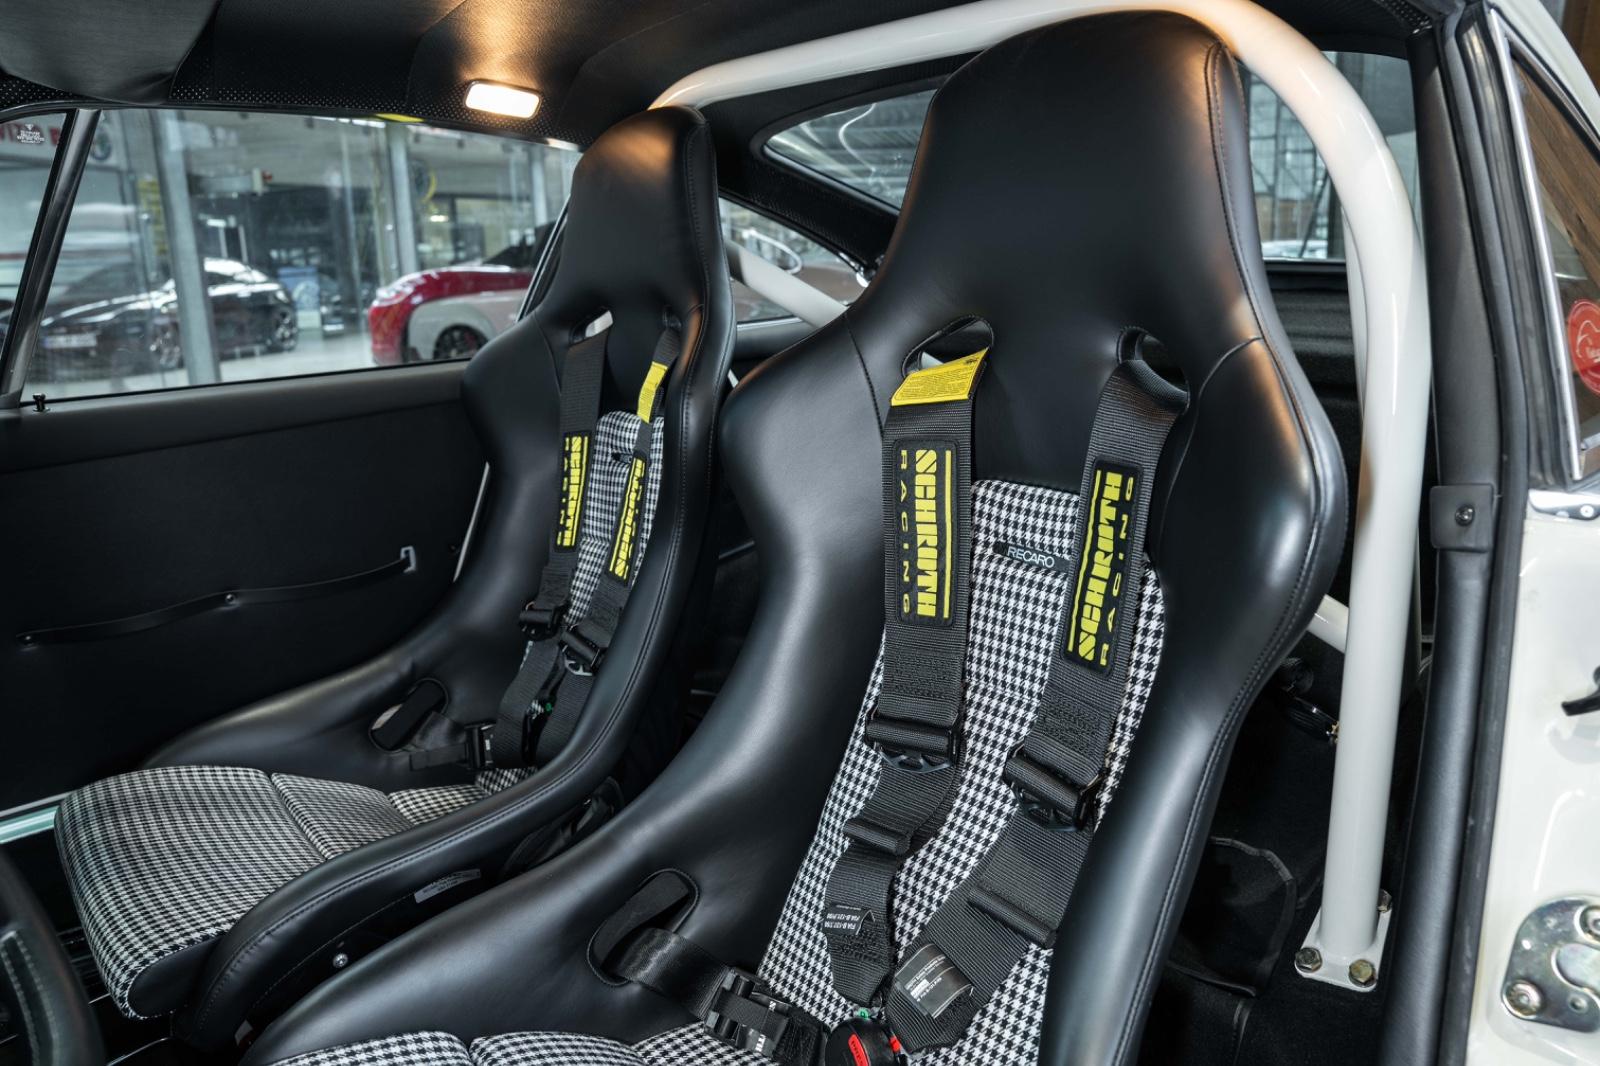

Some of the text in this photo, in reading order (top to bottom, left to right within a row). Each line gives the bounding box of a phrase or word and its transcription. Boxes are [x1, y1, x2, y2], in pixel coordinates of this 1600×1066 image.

[899, 449, 911, 613] RACING
[915, 449, 937, 617] SCHROTH
[1007, 546, 1055, 568] RECARO
[1078, 472, 1123, 661] SCHROTH
[1100, 477, 1134, 666] RACING
